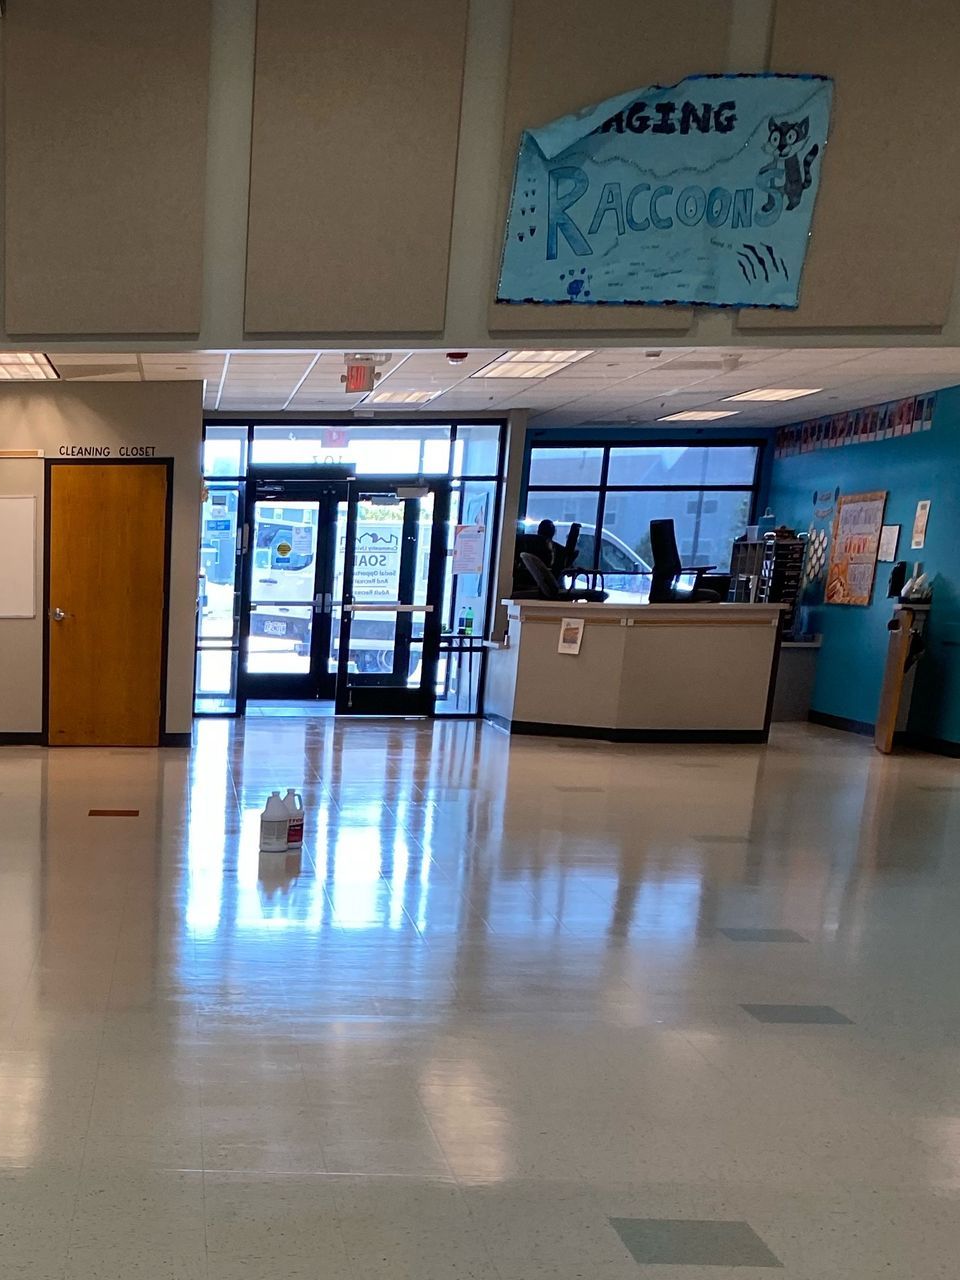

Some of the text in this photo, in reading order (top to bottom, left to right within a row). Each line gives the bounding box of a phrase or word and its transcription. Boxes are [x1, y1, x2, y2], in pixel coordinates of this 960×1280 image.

[598, 100, 738, 135] AGING
[547, 165, 785, 261] RACCOONS
[59, 445, 156, 457] CLEANING CLOSET
